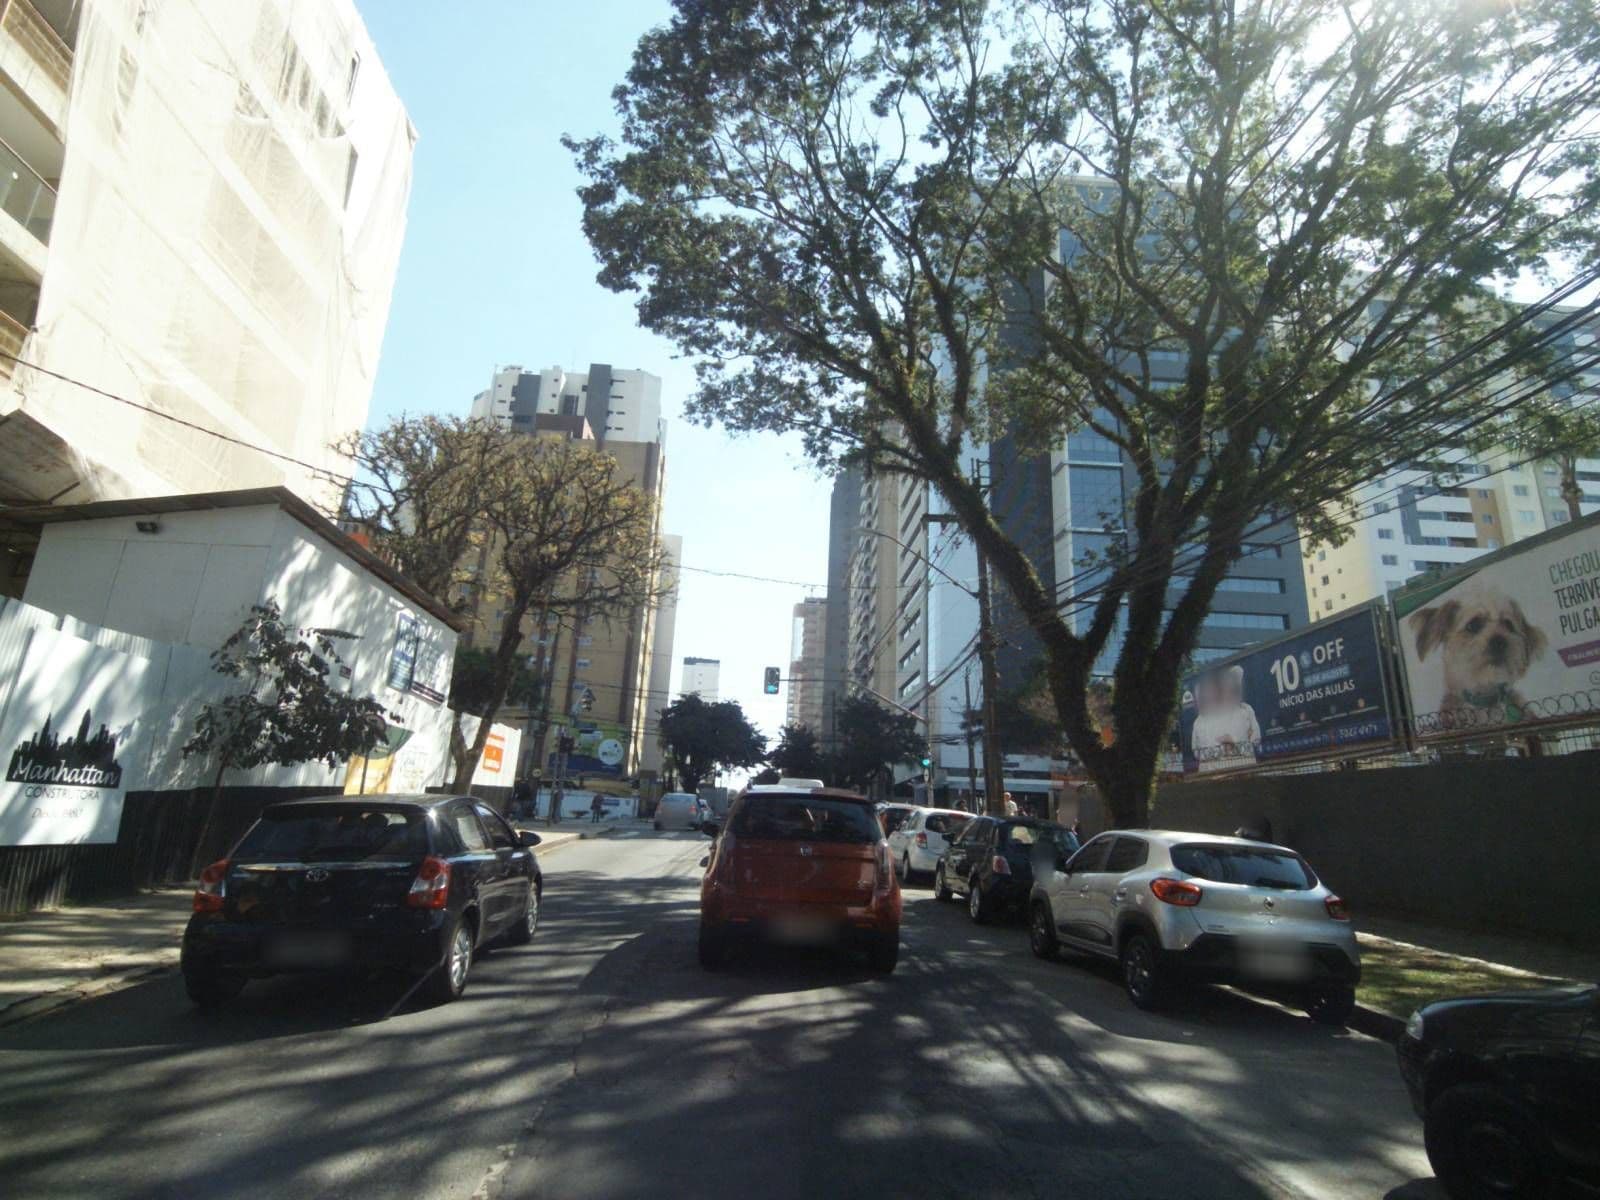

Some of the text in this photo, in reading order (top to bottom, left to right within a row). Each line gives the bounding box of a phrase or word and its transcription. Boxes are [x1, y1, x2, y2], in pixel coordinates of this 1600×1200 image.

[1548, 550, 1600, 584] CHEGOU
[1270, 655, 1300, 694] 10
[1312, 638, 1345, 664] OFF
[1279, 679, 1355, 708] INÍCIO DAS AULAS
[12, 756, 118, 785] Manhattan
